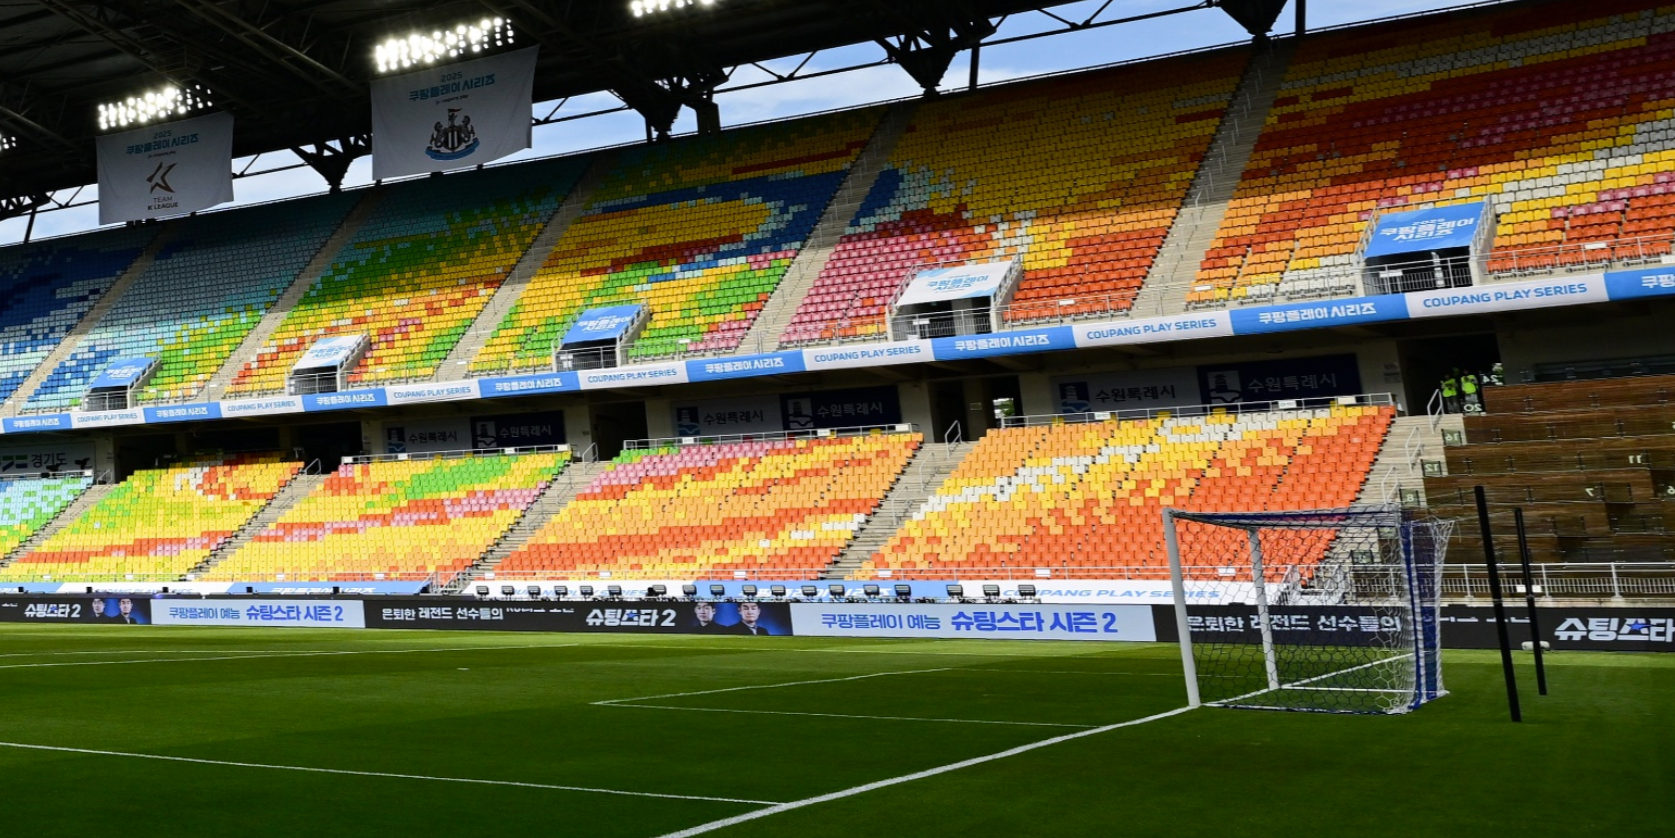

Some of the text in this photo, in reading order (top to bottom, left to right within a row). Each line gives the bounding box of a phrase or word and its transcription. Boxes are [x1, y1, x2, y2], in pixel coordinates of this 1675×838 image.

[441, 72, 462, 82] 2025
[410, 82, 460, 101] 쿠팡플레이
[462, 74, 495, 91] 시리즈
[153, 130, 172, 139] 2025
[126, 139, 169, 155] 쿠팡플레이
[171, 133, 199, 148] 시리즈
[154, 202, 178, 210] LEAGUE
[1380, 218, 1475, 236] 쿠팡플레이
[1423, 283, 1587, 308] COUPANG PLAY SERIES
[1259, 303, 1376, 324] 쿠팡플레이 시리즈
[1087, 318, 1217, 340] COUPANG PLAY SERIES
[955, 334, 1050, 351] 쿠팡플레이 시리즈
[814, 345, 921, 363] COUPANG PLAY SERIES
[705, 357, 785, 373] 쿠팡플레이 시리즈
[588, 368, 677, 383] COUPANG PLAY SERIES
[1248, 373, 1337, 393] 수원특례시
[393, 386, 471, 399] COUPANG PLAY SERIES
[495, 377, 563, 392] 쿠팡플레이 시리즈
[316, 393, 375, 405] 쿠팡플레이 시리즈
[1095, 385, 1176, 403] 수원특례시
[227, 400, 296, 412] COUPANG PLAY SERIES
[817, 402, 883, 418] 수원특례시
[117, 412, 138, 420] SERIES
[703, 409, 764, 426] 수원특례시
[409, 431, 458, 443] 수원특례시
[500, 424, 552, 438] 수원특례시
[31, 453, 67, 468] 경기도
[1098, 589, 1148, 597] PLAY
[24, 603, 82, 618] 슈팅스타 2
[169, 605, 344, 621] 쿠팡플레이 예능 슈팅스타 시즌 2
[382, 608, 416, 621] 은퇴한
[418, 607, 453, 619] 레전드
[456, 607, 504, 620] 선수들의
[585, 609, 676, 627] 슈팅스타 2
[821, 611, 1118, 633] 쿠팡플레이 예능 슈팅스타 시즌 2
[1187, 616, 1244, 632] 은퇴한
[1317, 615, 1401, 632] 선수들의
[1554, 617, 1675, 642] 슈팅스타
